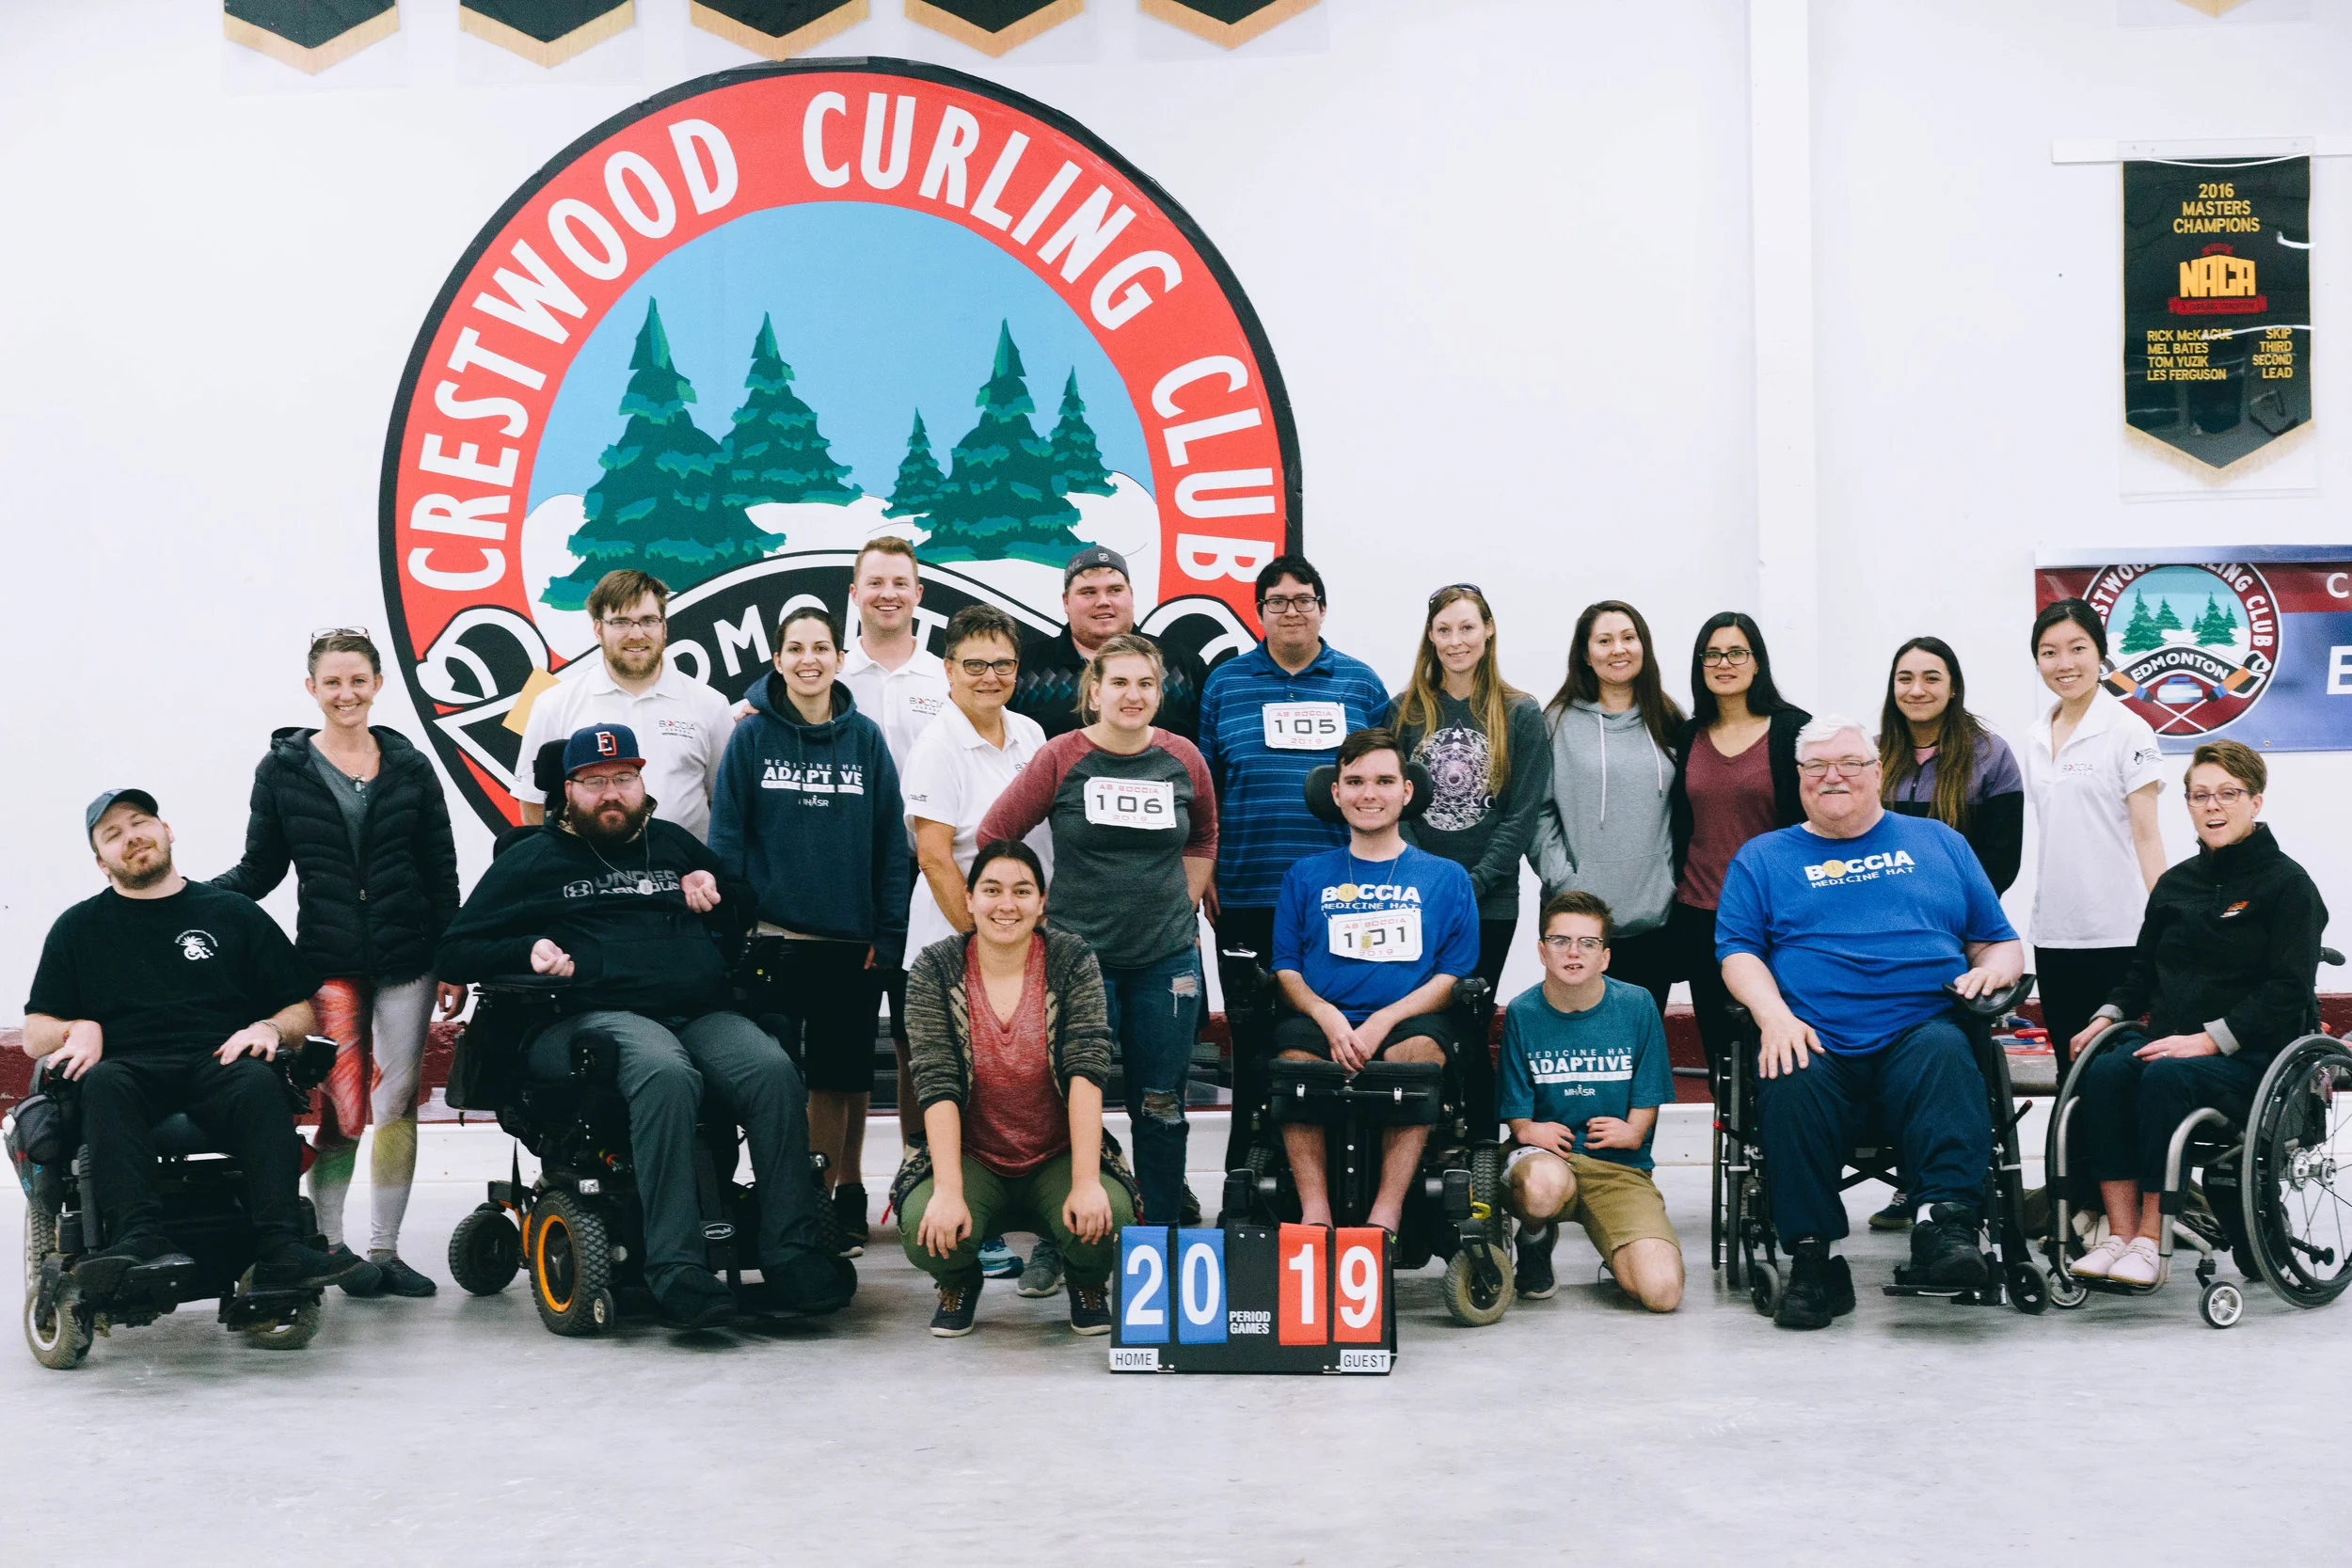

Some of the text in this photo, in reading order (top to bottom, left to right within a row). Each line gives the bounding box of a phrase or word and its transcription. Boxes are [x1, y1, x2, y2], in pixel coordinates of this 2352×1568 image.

[2198, 182, 2235, 198] 2016
[2182, 199, 2251, 216] MASTERS
[2172, 217, 2261, 233] CHAMPIONS
[2179, 254, 2257, 297] NACA
[2147, 329, 2174, 341] RICK
[2265, 327, 2293, 340] SKIP
[407, 91, 1276, 592] CRESTWOOD CURLING CLUB
[2259, 341, 2294, 353] THIRD
[2147, 342, 2209, 355] MEL BATES
[2147, 356, 2209, 368] TOM YUZIK
[2252, 354, 2293, 366] SECOND
[2147, 369, 2227, 381] LES FERGUSON
[2262, 367, 2294, 379] LEAD
[2246, 594, 2273, 646] CLUB
[2130, 652, 2230, 682] EDMONTON
[1274, 719, 1336, 735] 105
[842, 763, 864, 772] HAT
[763, 766, 864, 786] ADAPTVE
[1119, 785, 1160, 794] BOCCIA
[1096, 794, 1163, 815] 106
[1811, 866, 1915, 889] MEDICINE HAT
[1321, 902, 1384, 911] MEDICINE
[1364, 918, 1406, 927] BOCCIA
[1359, 948, 1393, 957] 2019
[1607, 1047, 1632, 1055] HAT
[1529, 1054, 1633, 1074] ADAPTIVE
[1229, 1310, 1271, 1323] PERIOD
[1230, 1323, 1270, 1335] GAMES
[1115, 1352, 1388, 1368] HOME GUEST
